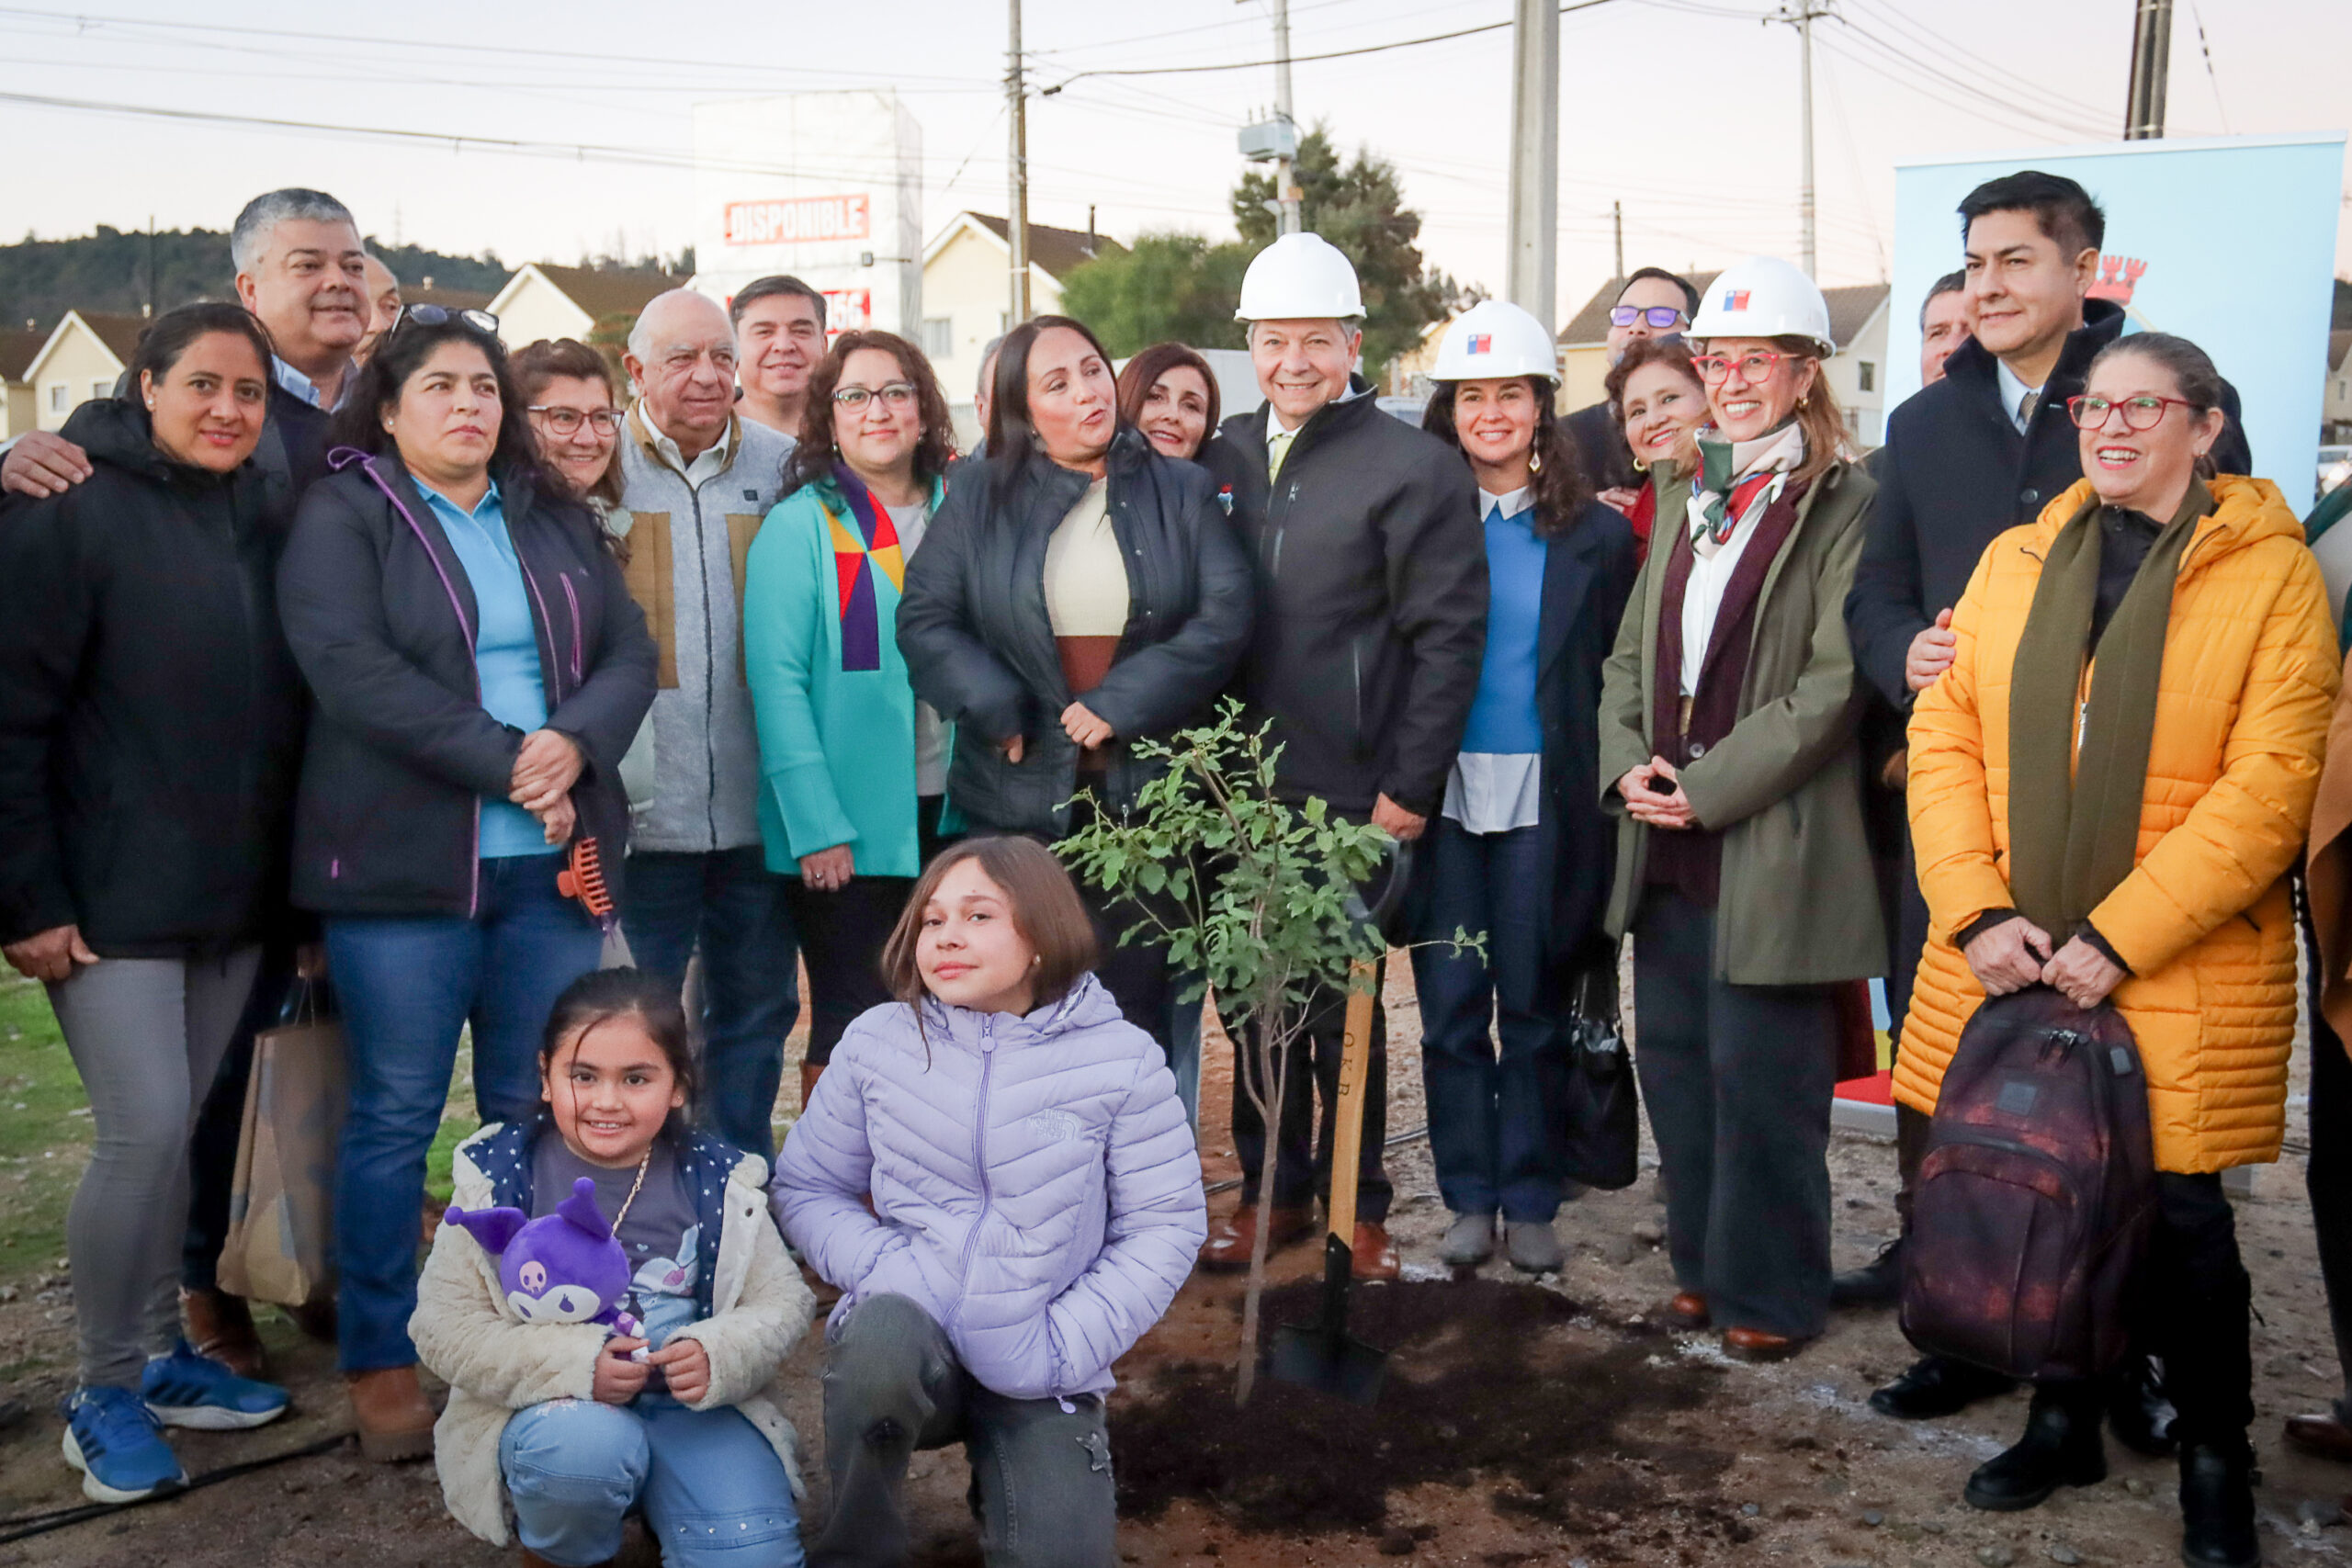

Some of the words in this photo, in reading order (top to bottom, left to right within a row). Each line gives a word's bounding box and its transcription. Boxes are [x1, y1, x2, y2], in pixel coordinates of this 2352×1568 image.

[729, 197, 865, 243] DISPONIBLE
[1044, 1109, 1066, 1120] THE
[1026, 1117, 1064, 1130] NORTH
